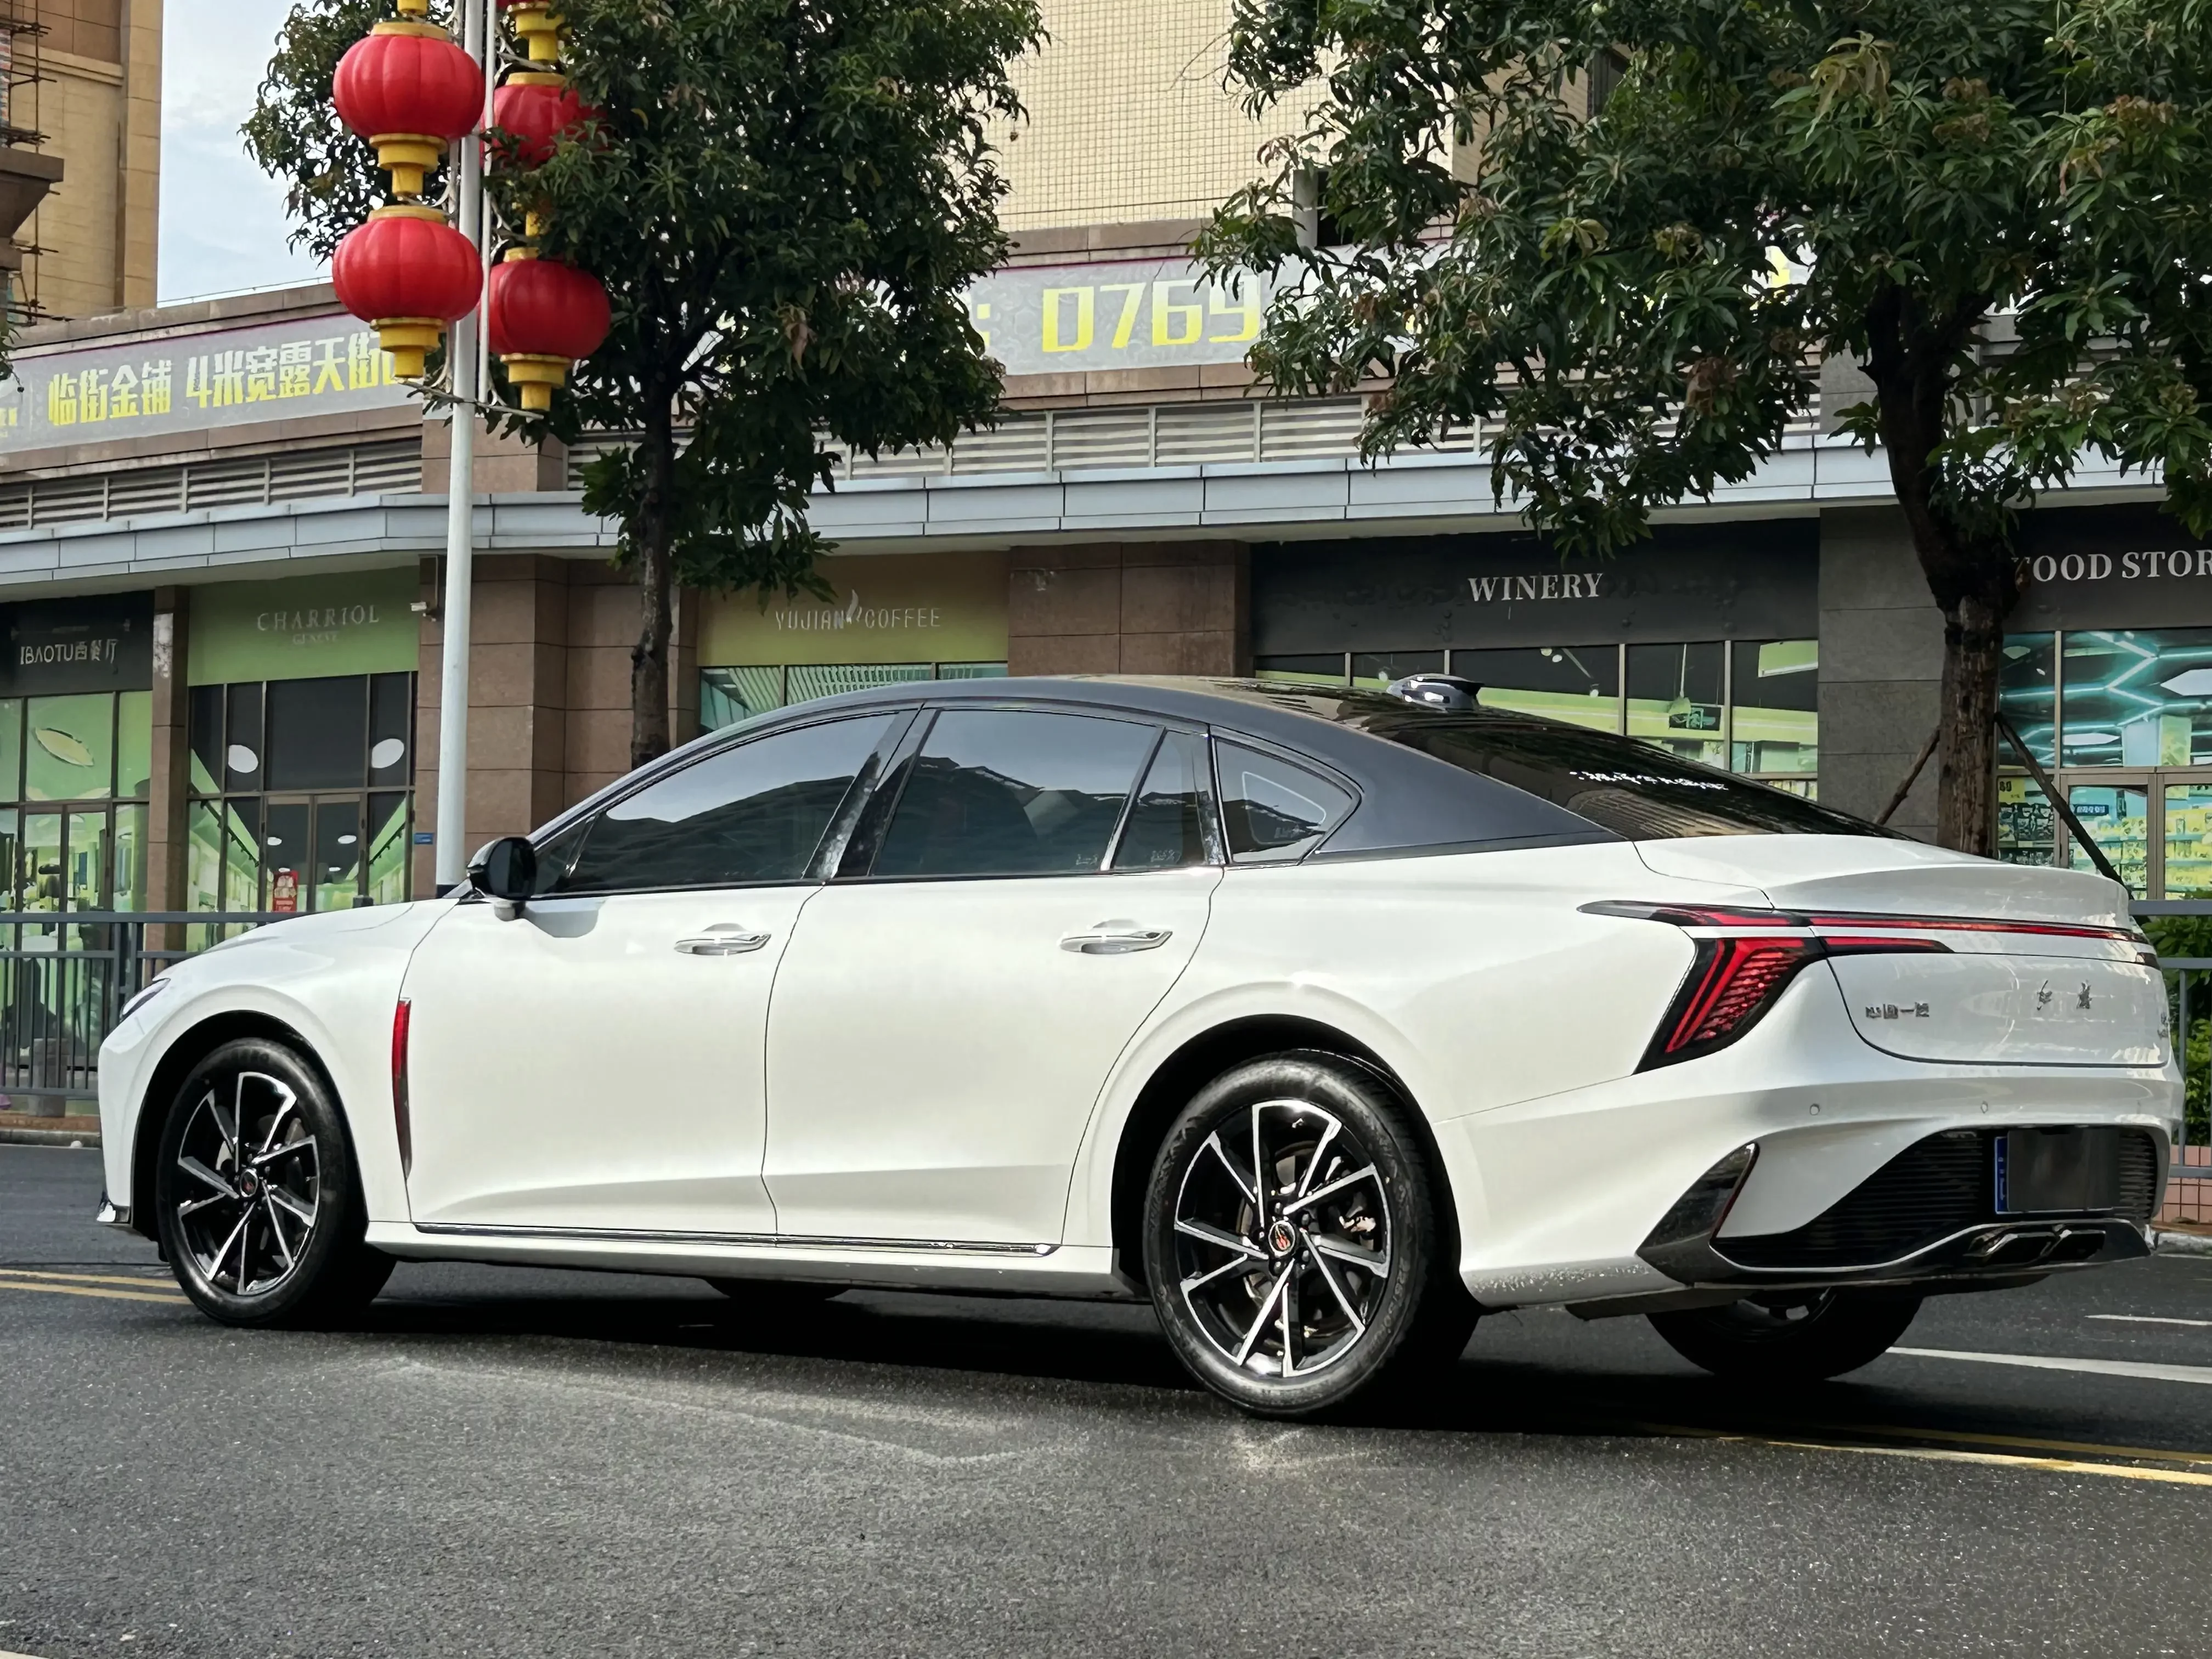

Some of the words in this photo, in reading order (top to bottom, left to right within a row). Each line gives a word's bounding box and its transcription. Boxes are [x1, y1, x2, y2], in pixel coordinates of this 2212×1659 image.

[48, 359, 171, 426] 临街金铺
[186, 331, 397, 408] 4米宽露天街
[2011, 555, 2112, 582] OOD
[1468, 573, 1603, 601] WINERY
[257, 605, 379, 631] CHARRIOL
[776, 610, 844, 630] YUJIAN
[865, 608, 941, 629] COFFEE
